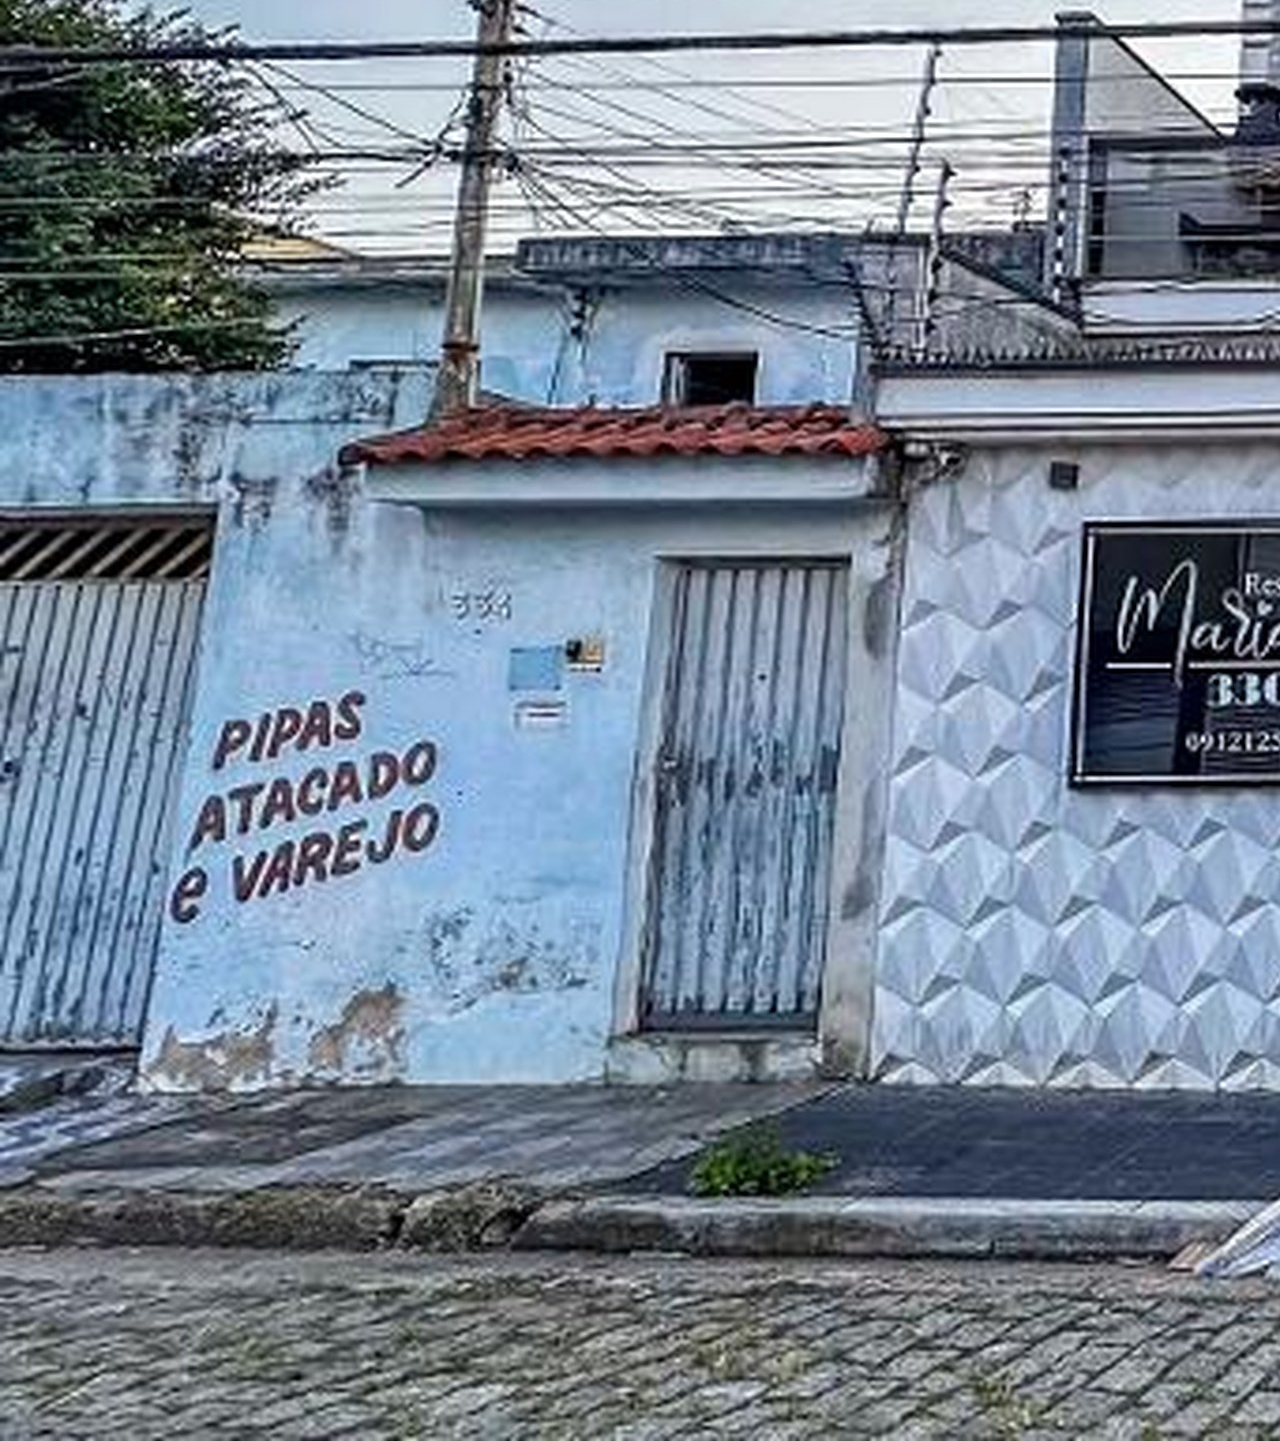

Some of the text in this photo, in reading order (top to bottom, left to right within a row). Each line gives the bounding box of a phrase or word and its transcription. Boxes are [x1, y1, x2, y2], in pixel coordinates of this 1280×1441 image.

[211, 690, 367, 770] PIPAS
[187, 740, 438, 850] ATACADO
[170, 802, 440, 924] e VAREJO
